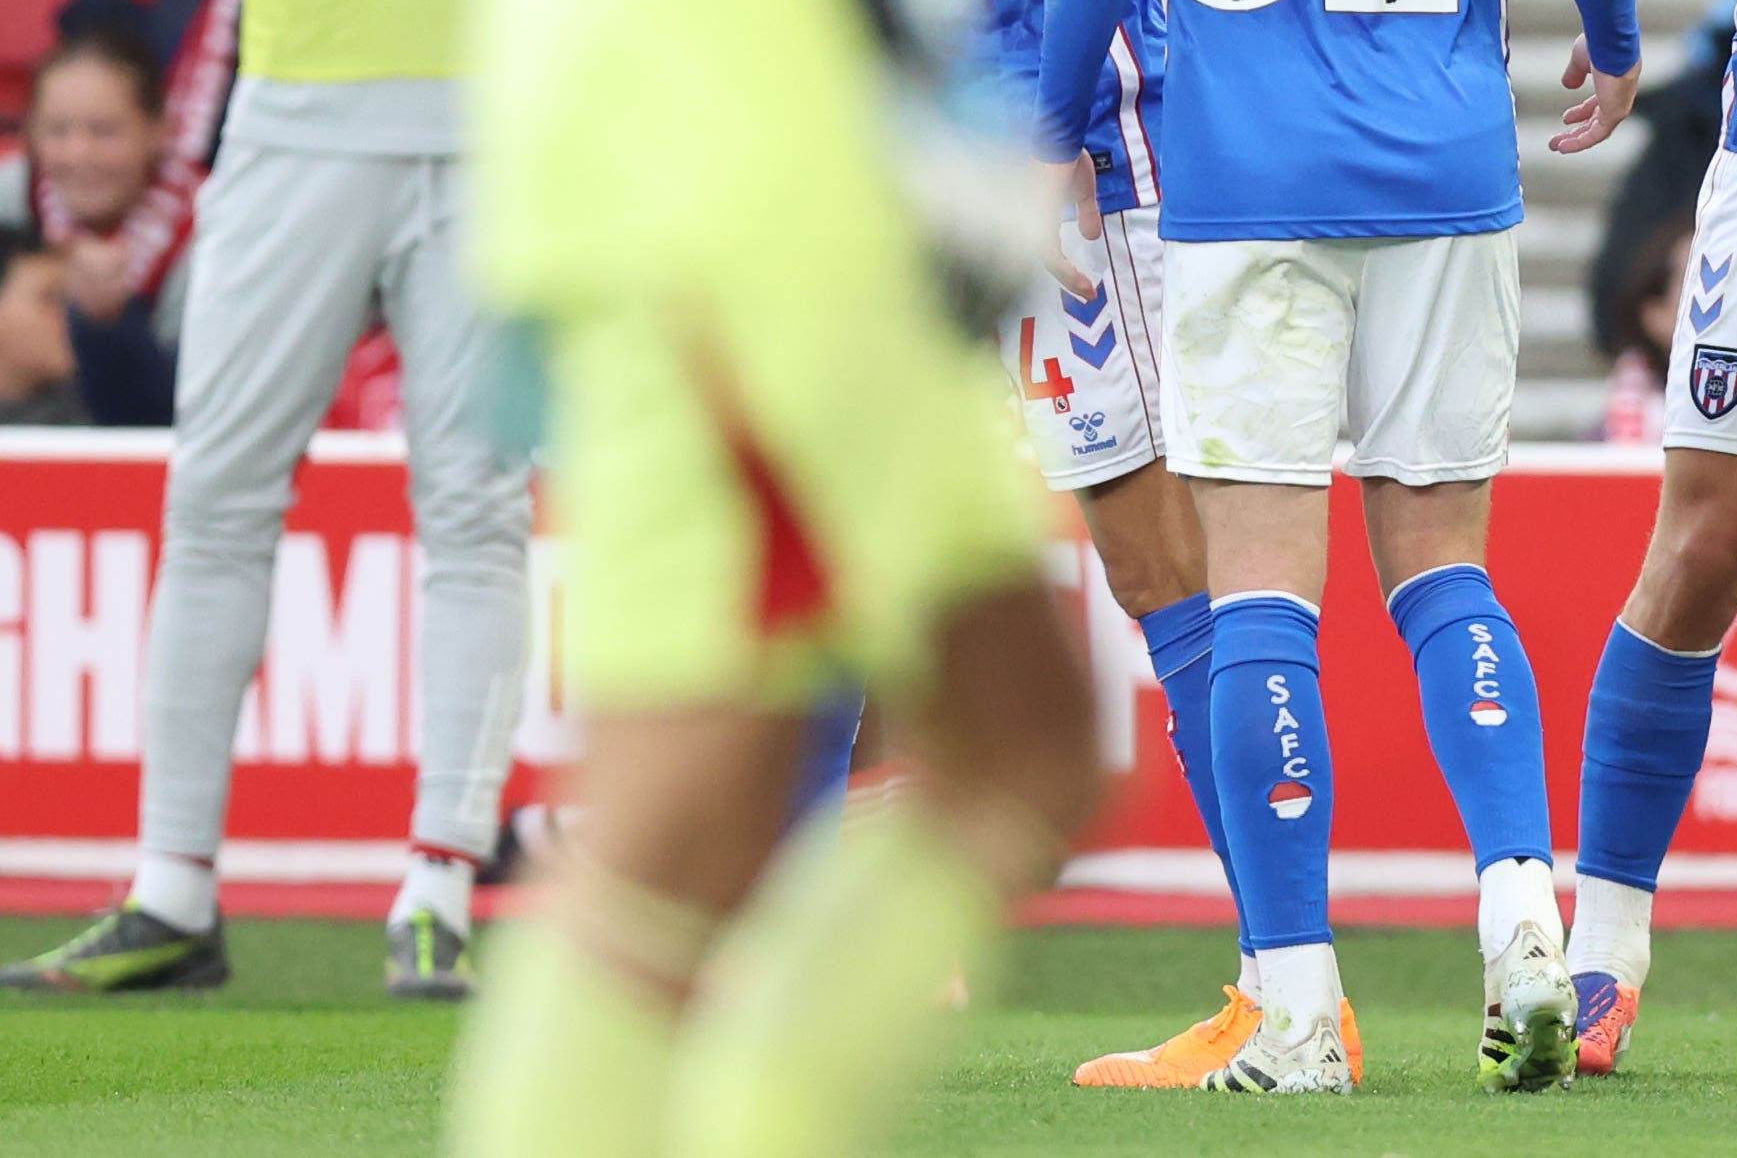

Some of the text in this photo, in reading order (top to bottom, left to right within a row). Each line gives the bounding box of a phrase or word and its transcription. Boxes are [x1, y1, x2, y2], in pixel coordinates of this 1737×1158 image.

[1072, 435, 1117, 456] hummel
[1466, 623, 1501, 699] SAFC
[1266, 674, 1311, 778] SAFC
